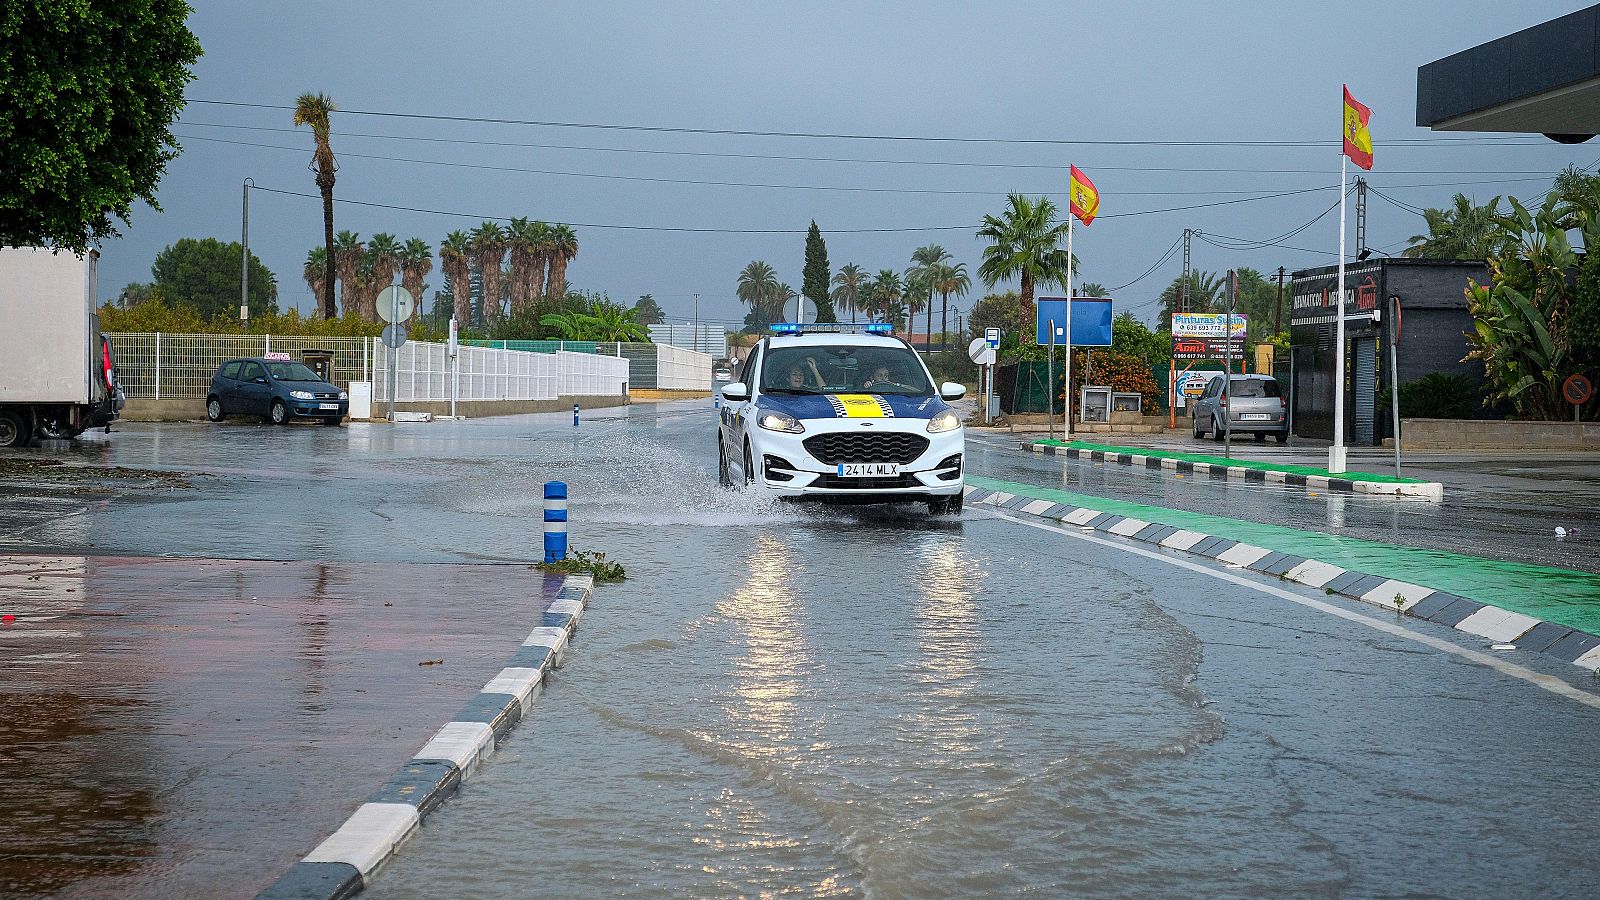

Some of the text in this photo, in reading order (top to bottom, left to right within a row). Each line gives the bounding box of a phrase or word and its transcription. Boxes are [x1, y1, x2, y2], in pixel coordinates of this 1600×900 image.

[1175, 315, 1214, 324] Pinturas
[846, 465, 896, 475] 2414 MLX
